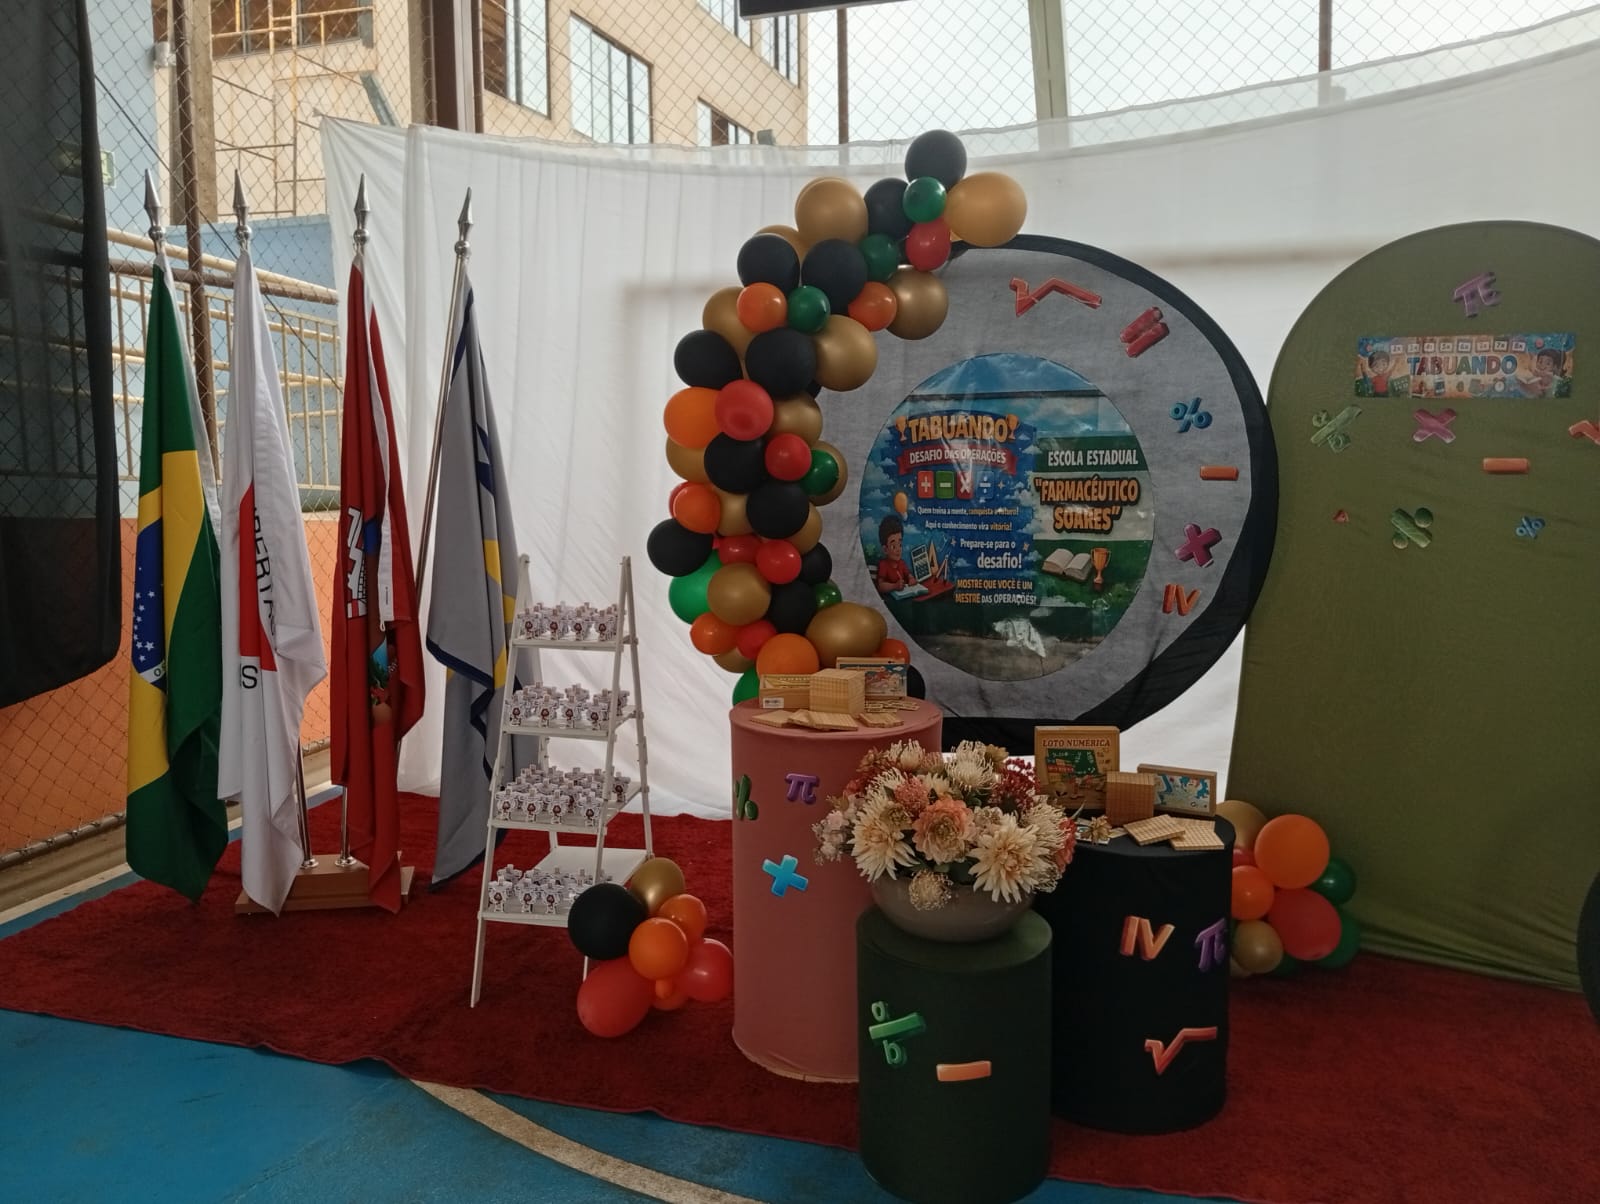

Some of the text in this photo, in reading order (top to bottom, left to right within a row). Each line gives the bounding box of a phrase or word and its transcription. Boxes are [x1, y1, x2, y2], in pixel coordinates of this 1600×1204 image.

[1407, 355, 1517, 376] TABUANDO
[908, 415, 1008, 443] TABUANDO
[909, 449, 942, 464] DESAFIO
[961, 449, 1006, 464] OPERAÇÕES
[1048, 449, 1138, 466] ESCOLA ESTADUAL
[960, 539, 993, 550] Prepare-se
[994, 541, 1009, 550] para
[977, 552, 1022, 569] desafio!
[957, 579, 982, 590] MOSTRE
[983, 580, 997, 590] QUE
[955, 593, 981, 604] MESTRE
[981, 594, 992, 604] DAS
[1043, 739, 1065, 747] LOTO
